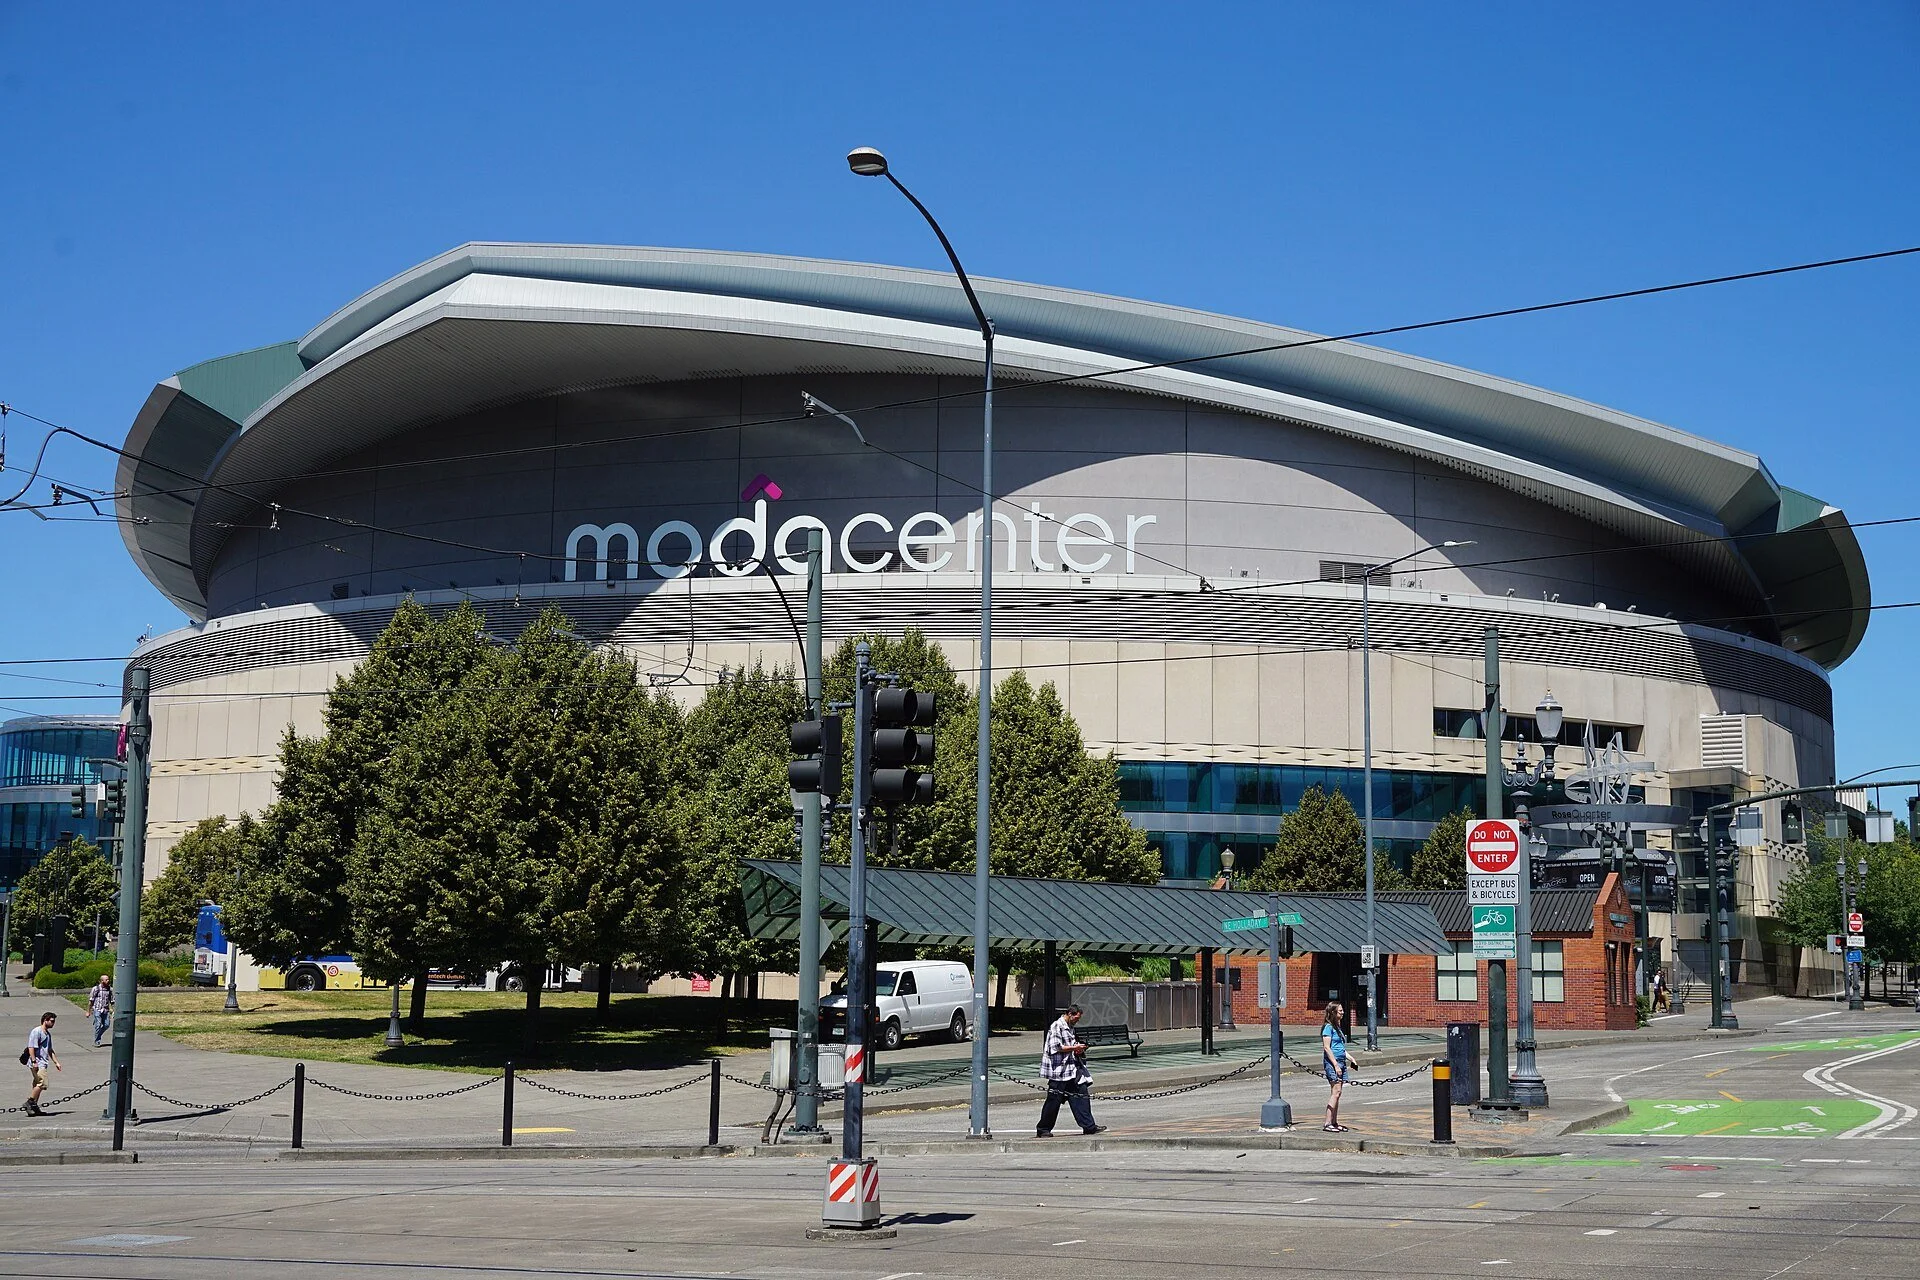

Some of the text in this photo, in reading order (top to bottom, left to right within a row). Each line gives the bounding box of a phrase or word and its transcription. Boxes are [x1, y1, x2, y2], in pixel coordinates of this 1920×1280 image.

[1474, 830, 1511, 839] DO NOT
[1477, 853, 1508, 863] ENTER
[1579, 873, 1595, 882] OPEN
[1654, 875, 1668, 884] OPEN
[1471, 879, 1516, 888] EXCEPT BUS
[1471, 890, 1516, 899] & BICYCLES
[1223, 921, 1232, 930] NE
[1233, 919, 1261, 929] HOLLADAY
